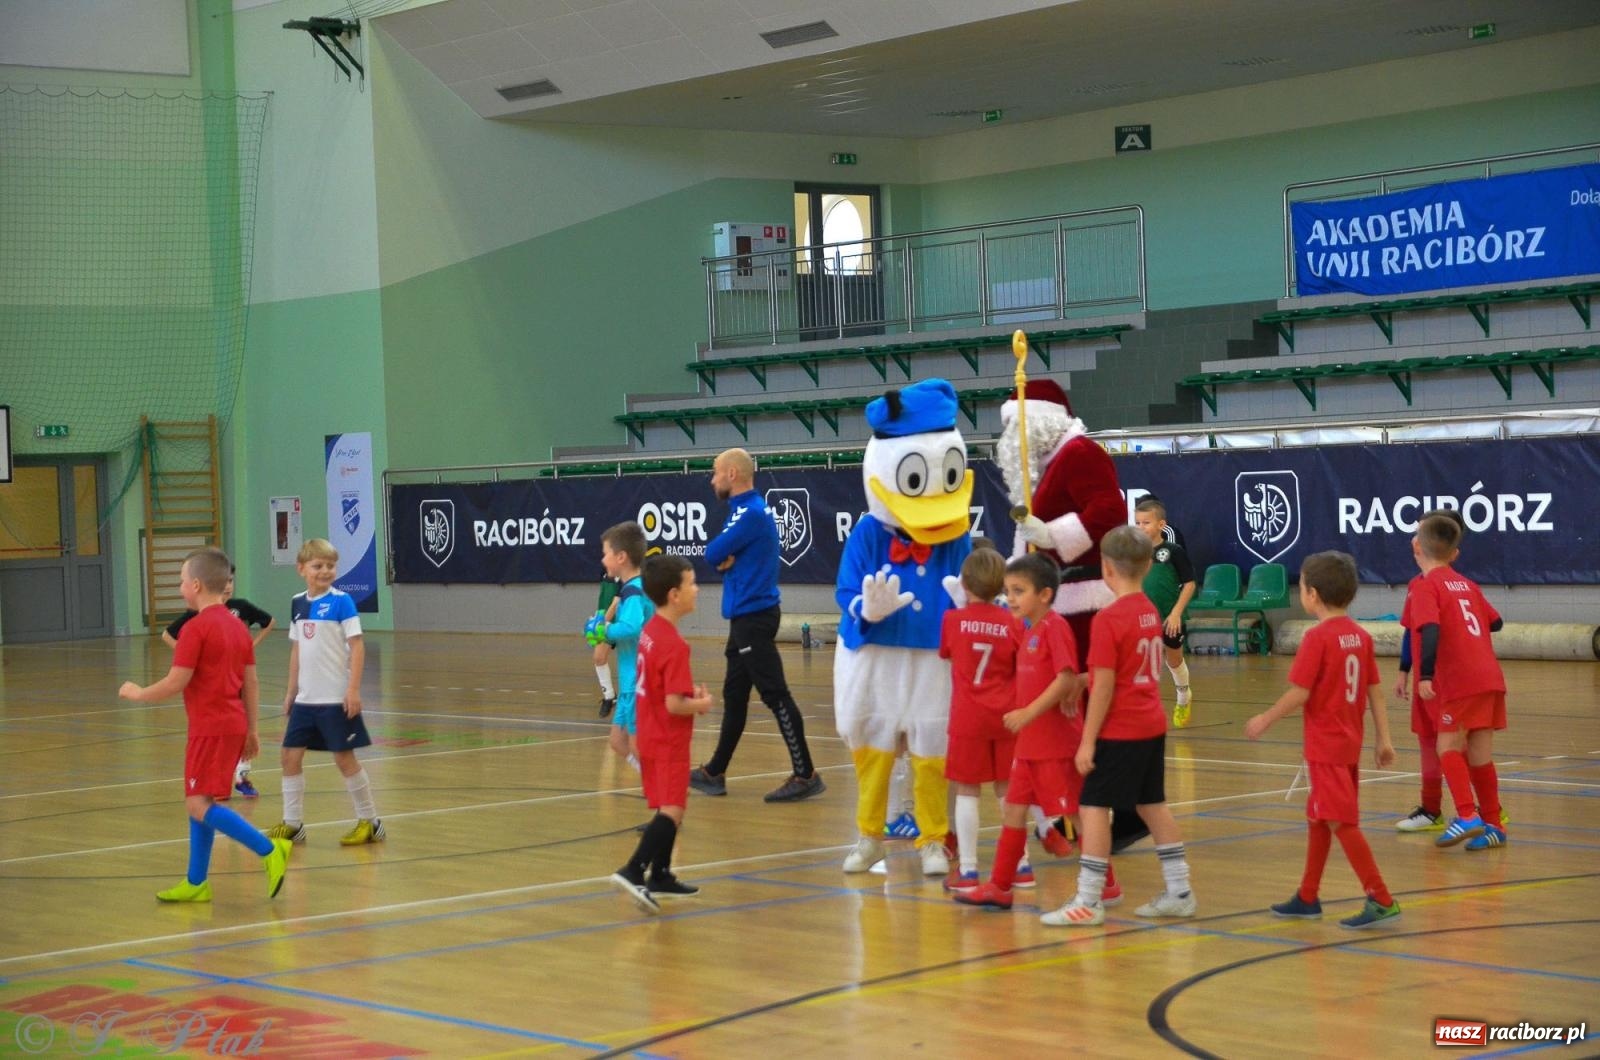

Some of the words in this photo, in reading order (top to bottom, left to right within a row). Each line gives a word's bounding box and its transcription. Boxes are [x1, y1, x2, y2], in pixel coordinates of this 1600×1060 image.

[1120, 133, 1145, 149] A
[1306, 201, 1465, 246] AKADEMIA
[1382, 224, 1546, 276] RACIBÓRZ
[474, 507, 585, 547] RACIBÓRZ
[637, 502, 708, 541] OSiR
[960, 620, 1008, 638] PIOTREK
[1458, 598, 1481, 637] 5
[1133, 635, 1163, 684] 20
[1338, 633, 1361, 649] KUBA
[972, 642, 993, 687] 7
[1345, 653, 1360, 703] 9
